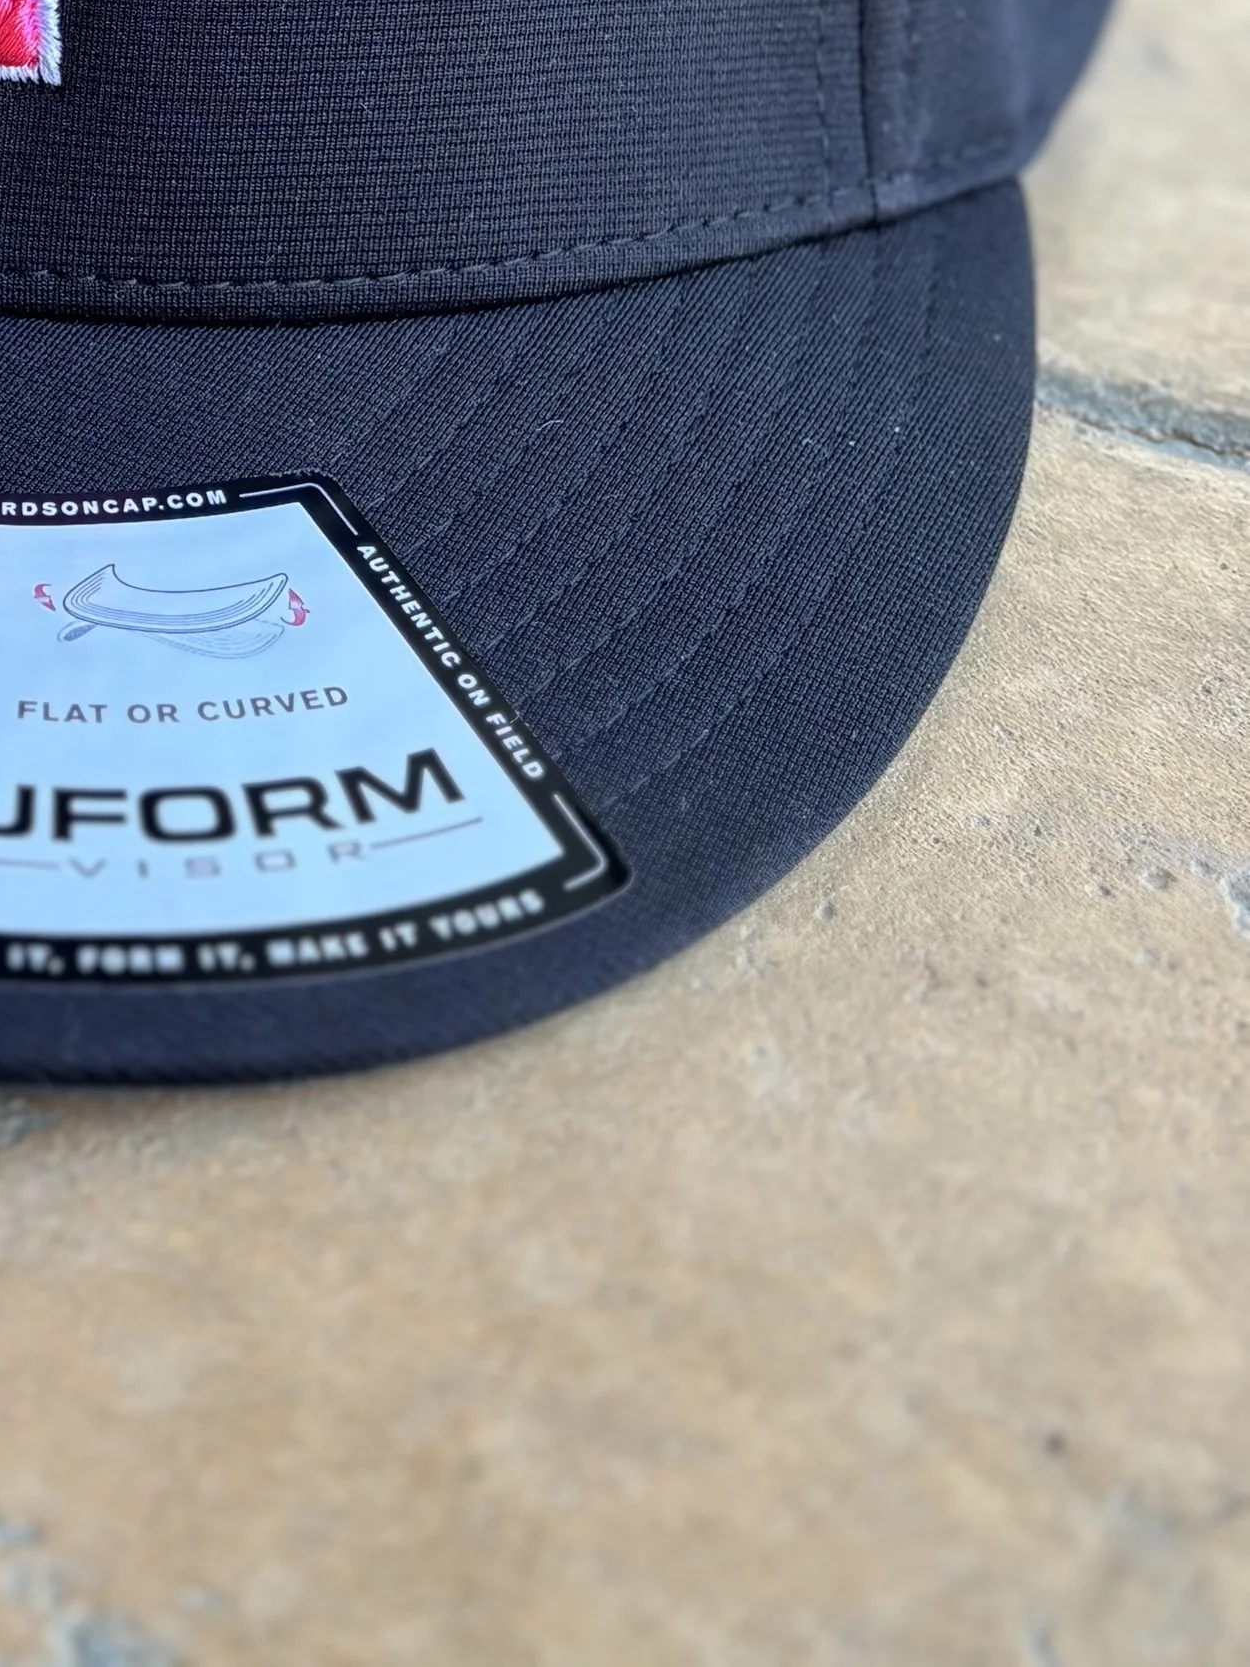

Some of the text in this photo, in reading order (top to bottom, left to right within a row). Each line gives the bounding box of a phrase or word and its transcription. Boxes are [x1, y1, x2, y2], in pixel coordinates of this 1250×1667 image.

[356, 544, 546, 780] AUTHENTIC ON FIELD
[17, 685, 349, 724] FLAT OR CURVED
[67, 839, 368, 880] VISOR
[264, 930, 371, 968] MAKE
[378, 920, 420, 952] IT
[427, 887, 546, 940] YOURS
